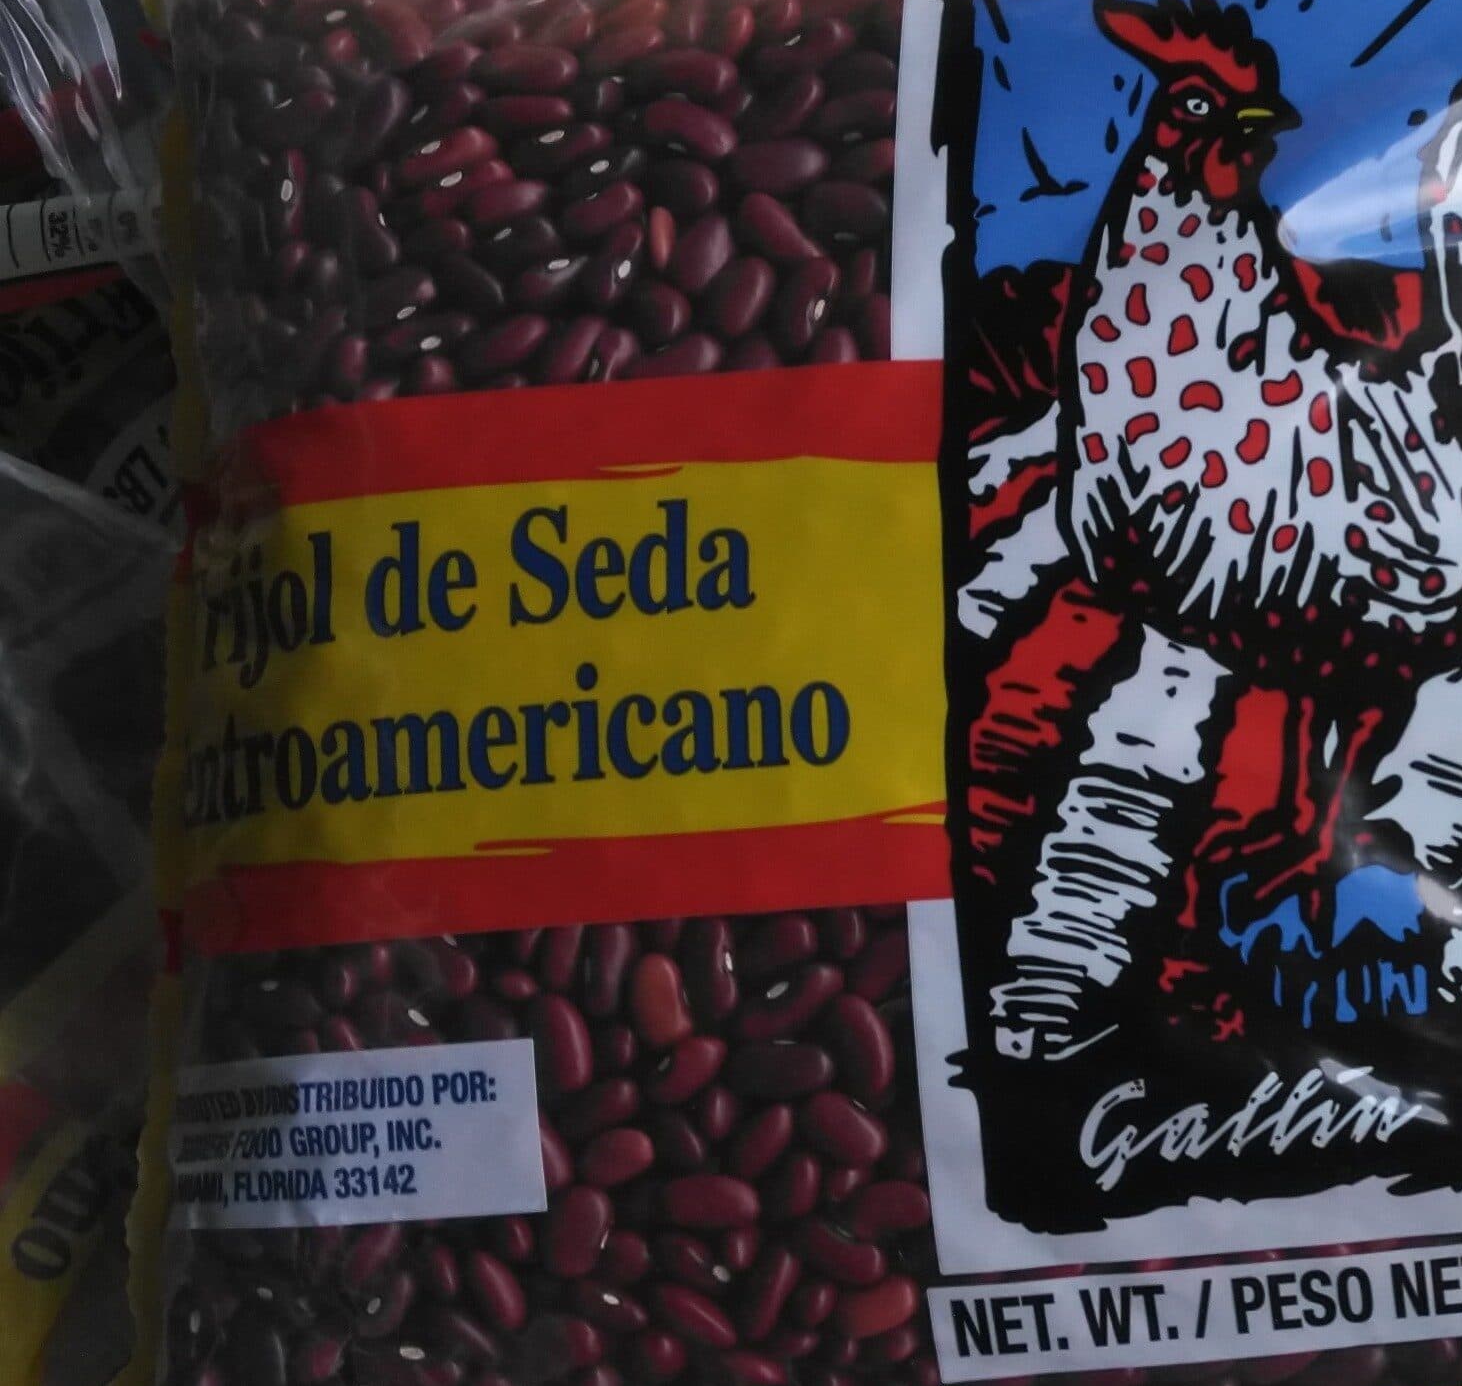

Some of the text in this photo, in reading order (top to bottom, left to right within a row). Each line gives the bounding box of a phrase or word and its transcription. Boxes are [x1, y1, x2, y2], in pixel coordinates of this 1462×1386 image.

[203, 496, 757, 691] rijol de Seda
[184, 662, 851, 829] ntroamericano
[432, 1069, 498, 1104] POR:
[289, 1117, 381, 1160] GROUP,
[387, 1116, 442, 1152] INC.
[233, 1164, 328, 1203] FLORIDA
[333, 1163, 417, 1199] 33142
[950, 1295, 1070, 1360] NET.
[1084, 1287, 1181, 1351] WT.
[1195, 1275, 1214, 1339] /
[1234, 1265, 1374, 1337] PESO
